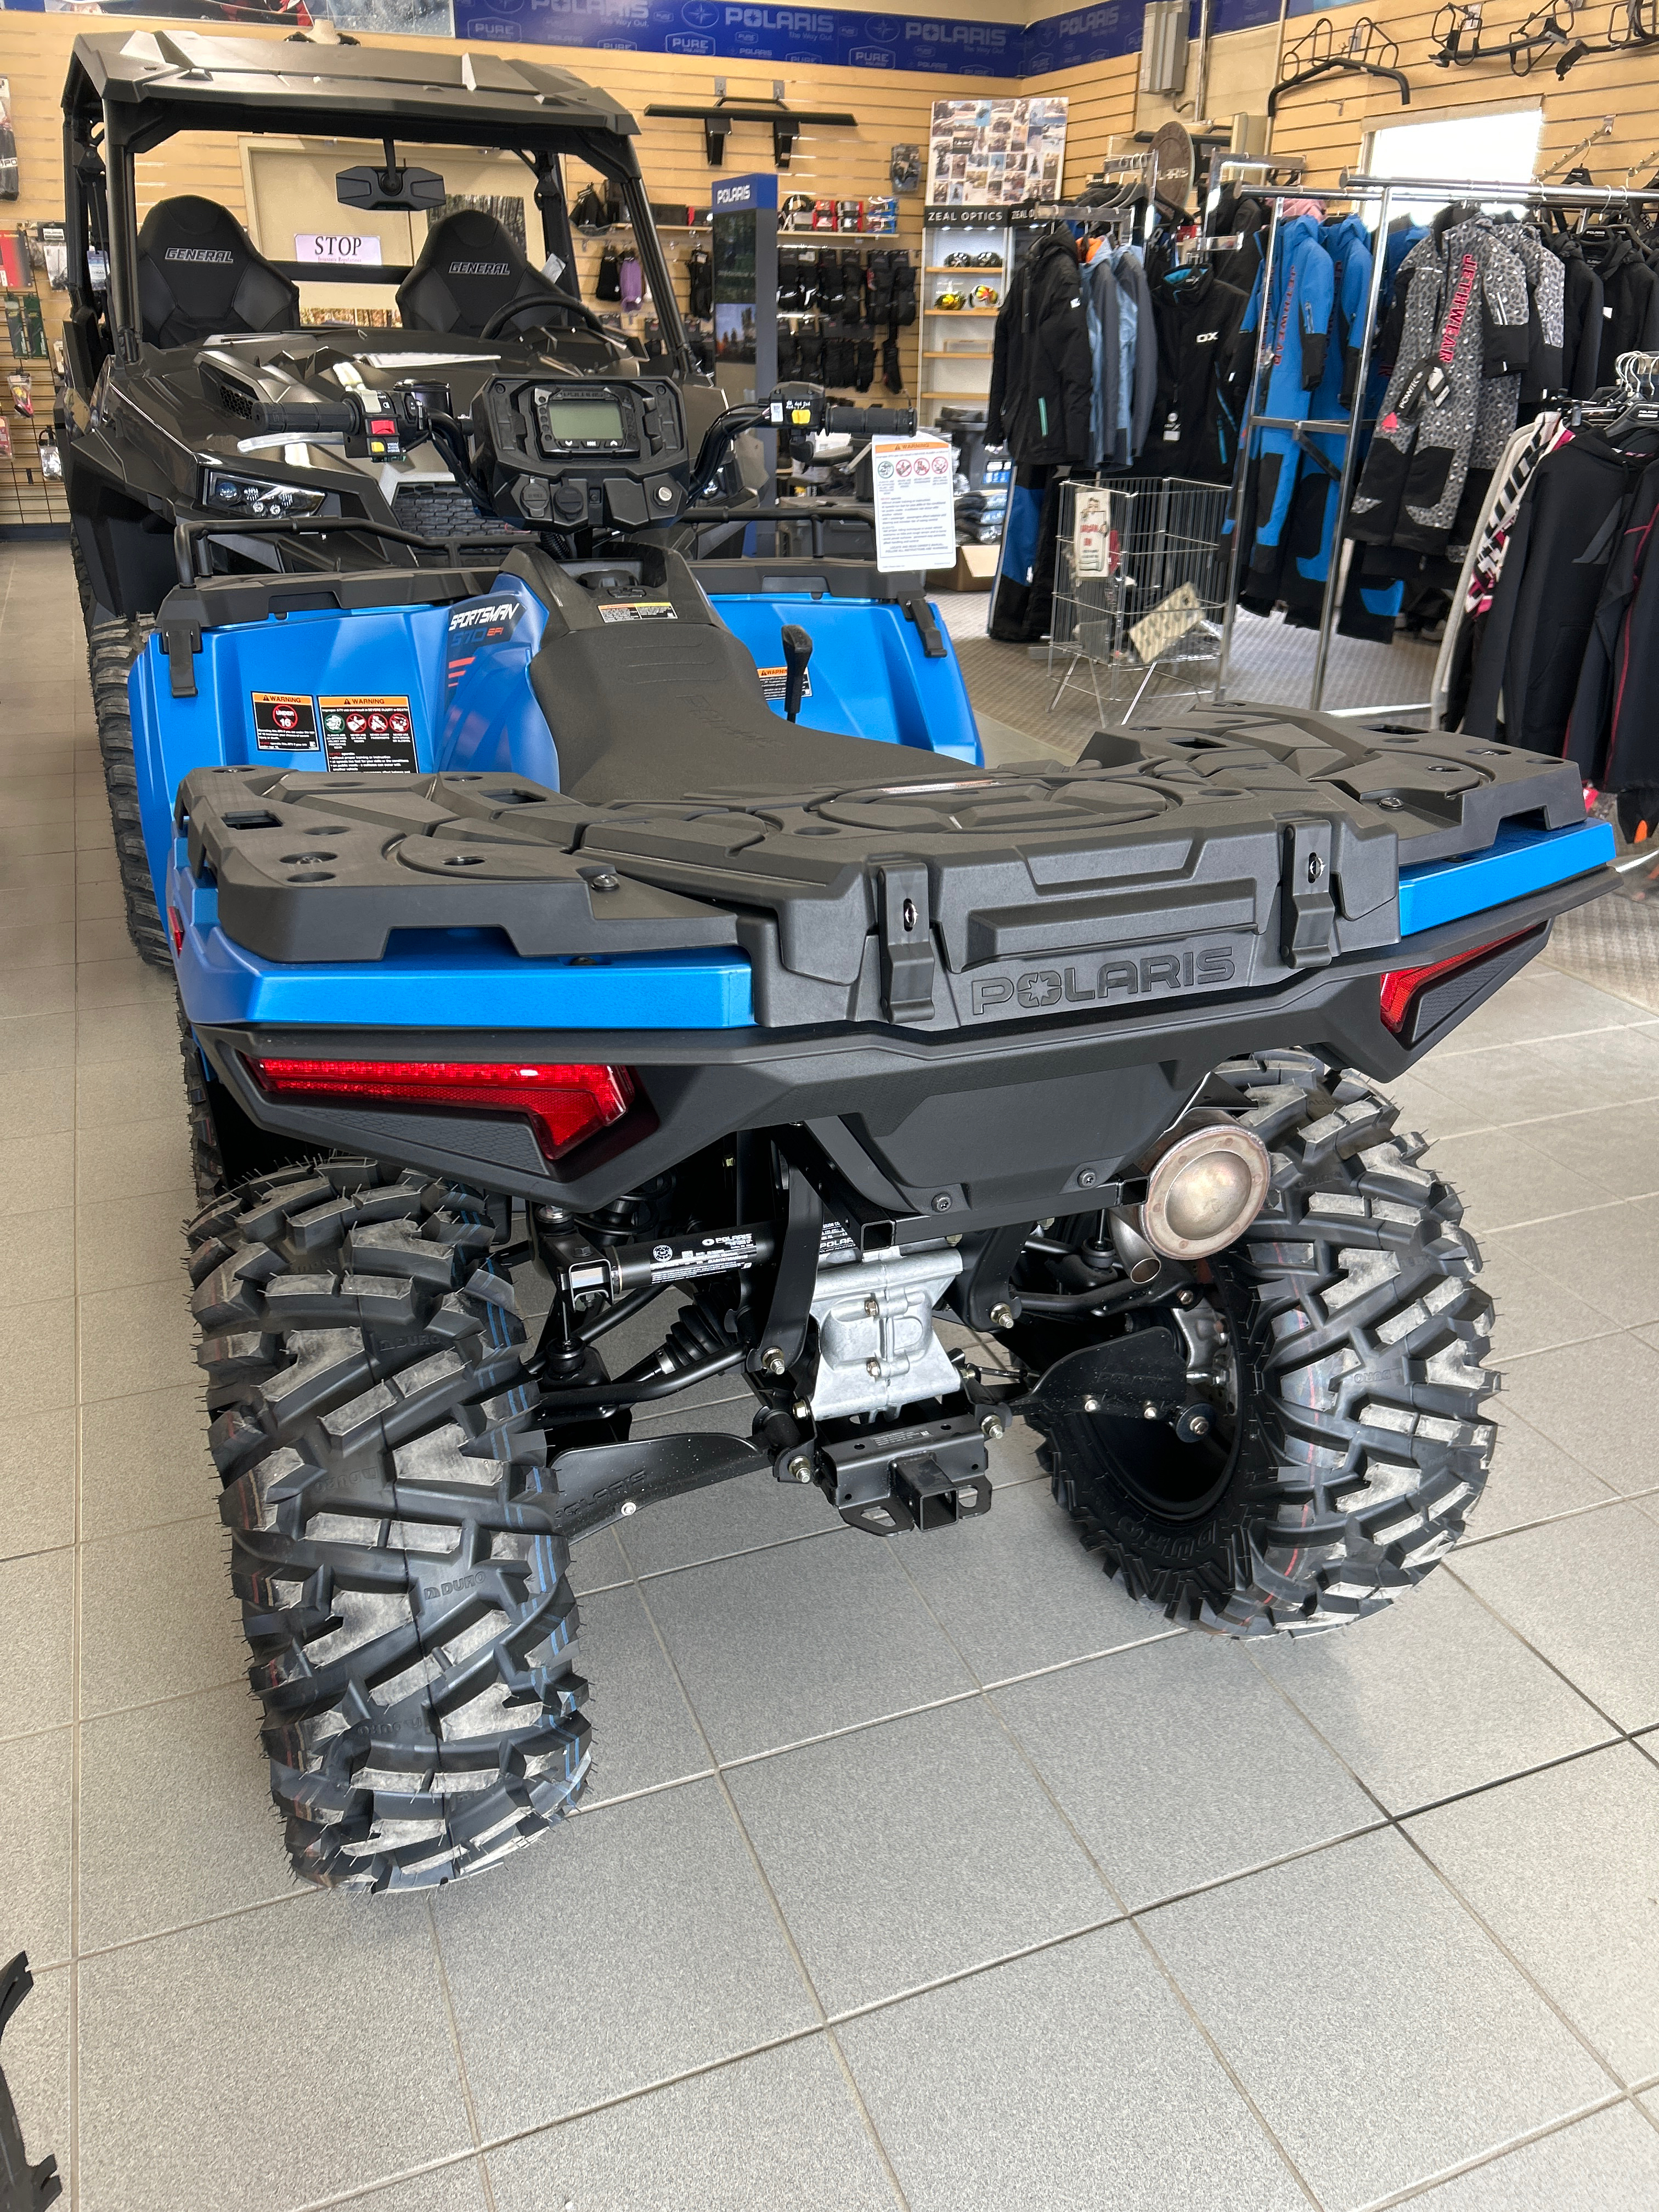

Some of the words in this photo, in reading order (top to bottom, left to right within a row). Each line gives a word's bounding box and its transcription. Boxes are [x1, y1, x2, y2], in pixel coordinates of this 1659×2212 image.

[725, 7, 834, 32] POLARIS
[1059, 5, 1120, 38] POLARIS
[475, 23, 514, 36] PURE
[906, 22, 1006, 46] POLARIS
[672, 37, 709, 49] PURE
[855, 52, 889, 63] PURE
[717, 185, 751, 204] POLARIS
[928, 212, 957, 221] ZEAL
[961, 212, 1003, 221] OPTICS
[165, 247, 233, 263] GENERAL
[314, 236, 362, 256] STOP
[449, 262, 511, 275] GENERAL
[1438, 254, 1478, 363] JETHWEAR
[449, 603, 520, 631] SPORTSMAN
[452, 627, 488, 646] 570
[486, 627, 504, 636] EFI
[279, 718, 291, 727] 16
[972, 947, 1236, 1015] POLARIS
[715, 1233, 752, 1244] POLARIS
[394, 1333, 442, 1349] DURO
[441, 1571, 486, 1595] DURO
